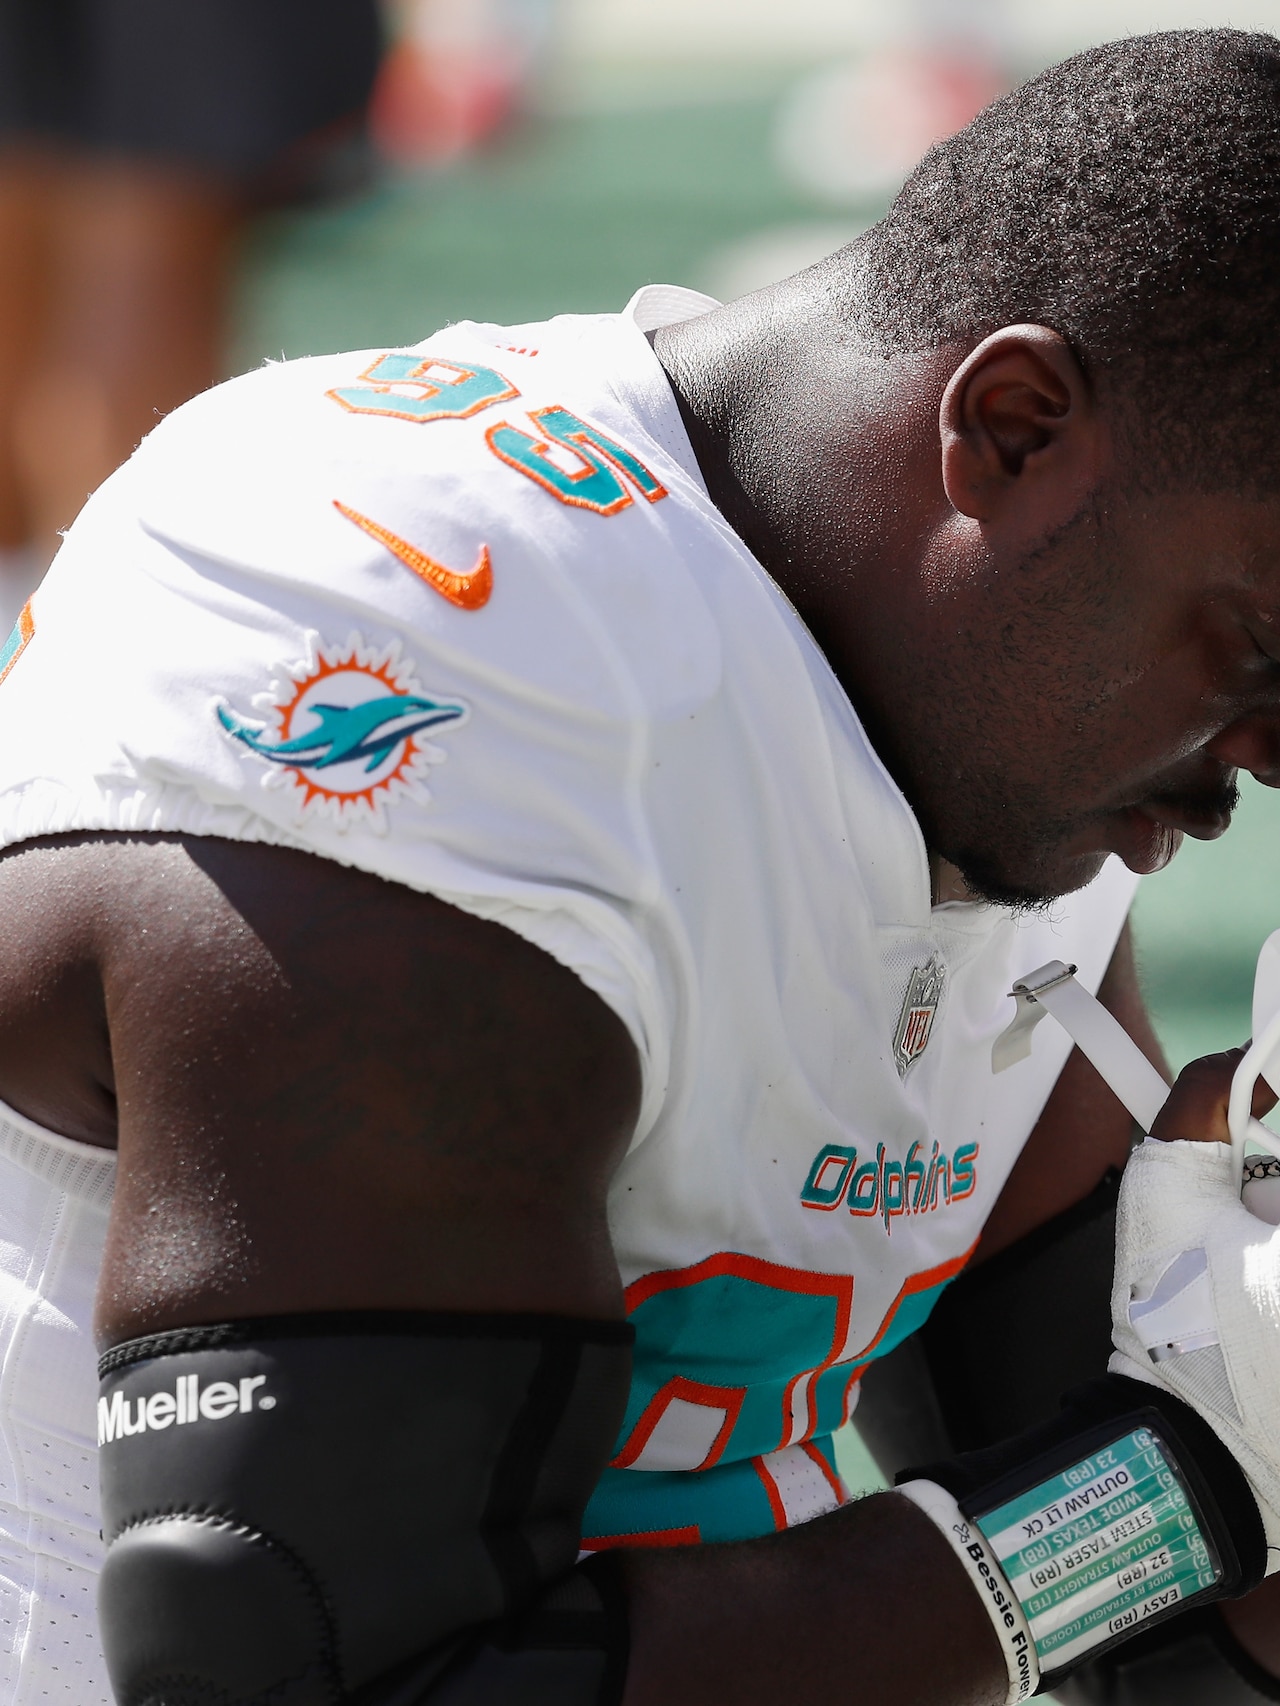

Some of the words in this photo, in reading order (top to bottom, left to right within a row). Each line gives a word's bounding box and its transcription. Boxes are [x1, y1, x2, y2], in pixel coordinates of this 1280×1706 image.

[324, 353, 669, 517] 95
[901, 1010, 931, 1057] NFL
[800, 1140, 980, 1237] Dolphins
[1095, 1450, 1118, 1469] 23
[1144, 1451, 1164, 1470] 7)
[1062, 1460, 1097, 1489] (RB)
[1156, 1472, 1175, 1490] 6)
[1064, 1470, 1129, 1516] OUTLAW
[1098, 1490, 1143, 1522] WIDE
[1022, 1519, 1044, 1539] CK
[1044, 1506, 1064, 1526] LT
[1110, 1510, 1153, 1542] STEM
[1177, 1514, 1194, 1532] 4)
[1053, 1514, 1102, 1548] TEXAS
[1019, 1538, 1053, 1567] (RB)
[1064, 1535, 1111, 1570] TASER
[1111, 1533, 1162, 1570] OUTLAW
[1149, 1551, 1169, 1570] 32
[966, 1542, 1015, 1629] Bessie
[1029, 1560, 1062, 1589] (RB)
[1053, 1562, 1110, 1600] STRAIGHT
[1116, 1561, 1147, 1590] (RB)
[1149, 1570, 1175, 1589] WIDE
[1197, 1572, 1214, 1588] 1)
[1028, 1593, 1053, 1614] (TE)
[1133, 1587, 1146, 1596] RT
[1142, 1588, 1179, 1616] EASY
[1083, 1594, 1131, 1626] STRAIGHT
[1109, 1608, 1138, 1634] (RB)
[1041, 1620, 1082, 1649] (LOOKS)
